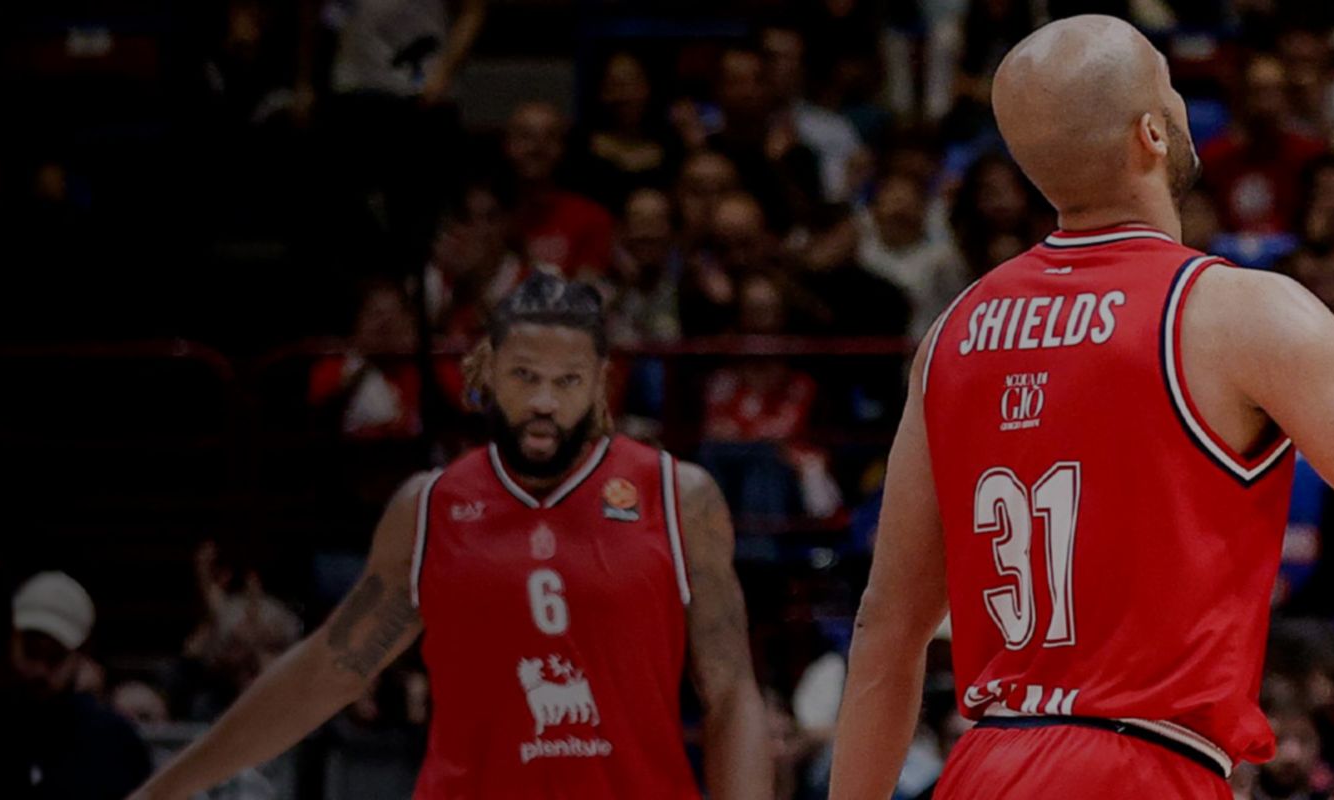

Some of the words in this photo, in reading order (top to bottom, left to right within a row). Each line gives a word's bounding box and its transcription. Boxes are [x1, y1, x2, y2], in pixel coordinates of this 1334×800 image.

[959, 290, 1126, 356] SHIELDS
[974, 461, 1081, 650] 31
[526, 568, 569, 636] 6
